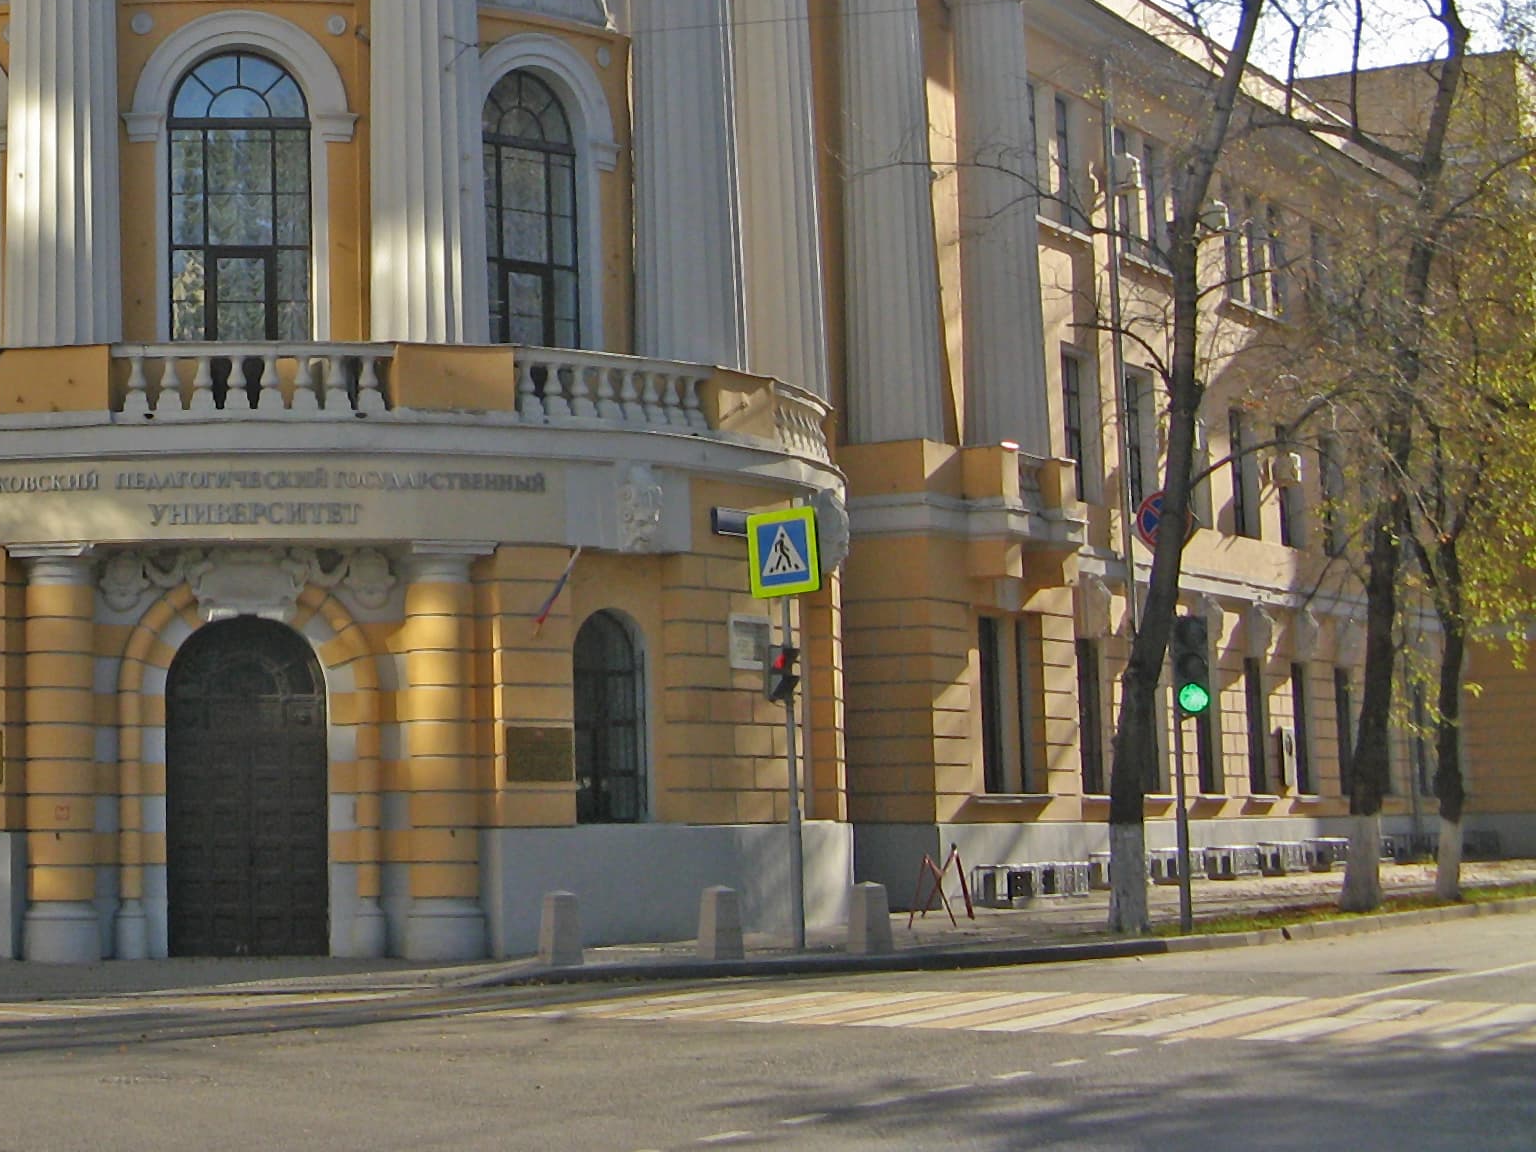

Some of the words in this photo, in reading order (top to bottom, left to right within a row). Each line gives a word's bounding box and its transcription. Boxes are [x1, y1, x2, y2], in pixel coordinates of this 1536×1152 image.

[115, 468, 328, 491] ПЕДАГОГИЧЕСКИЙ
[334, 470, 546, 493] ГОСУДАРСТВЕННЫЙ
[148, 502, 362, 526] УНИВЕРСИТЕТ
